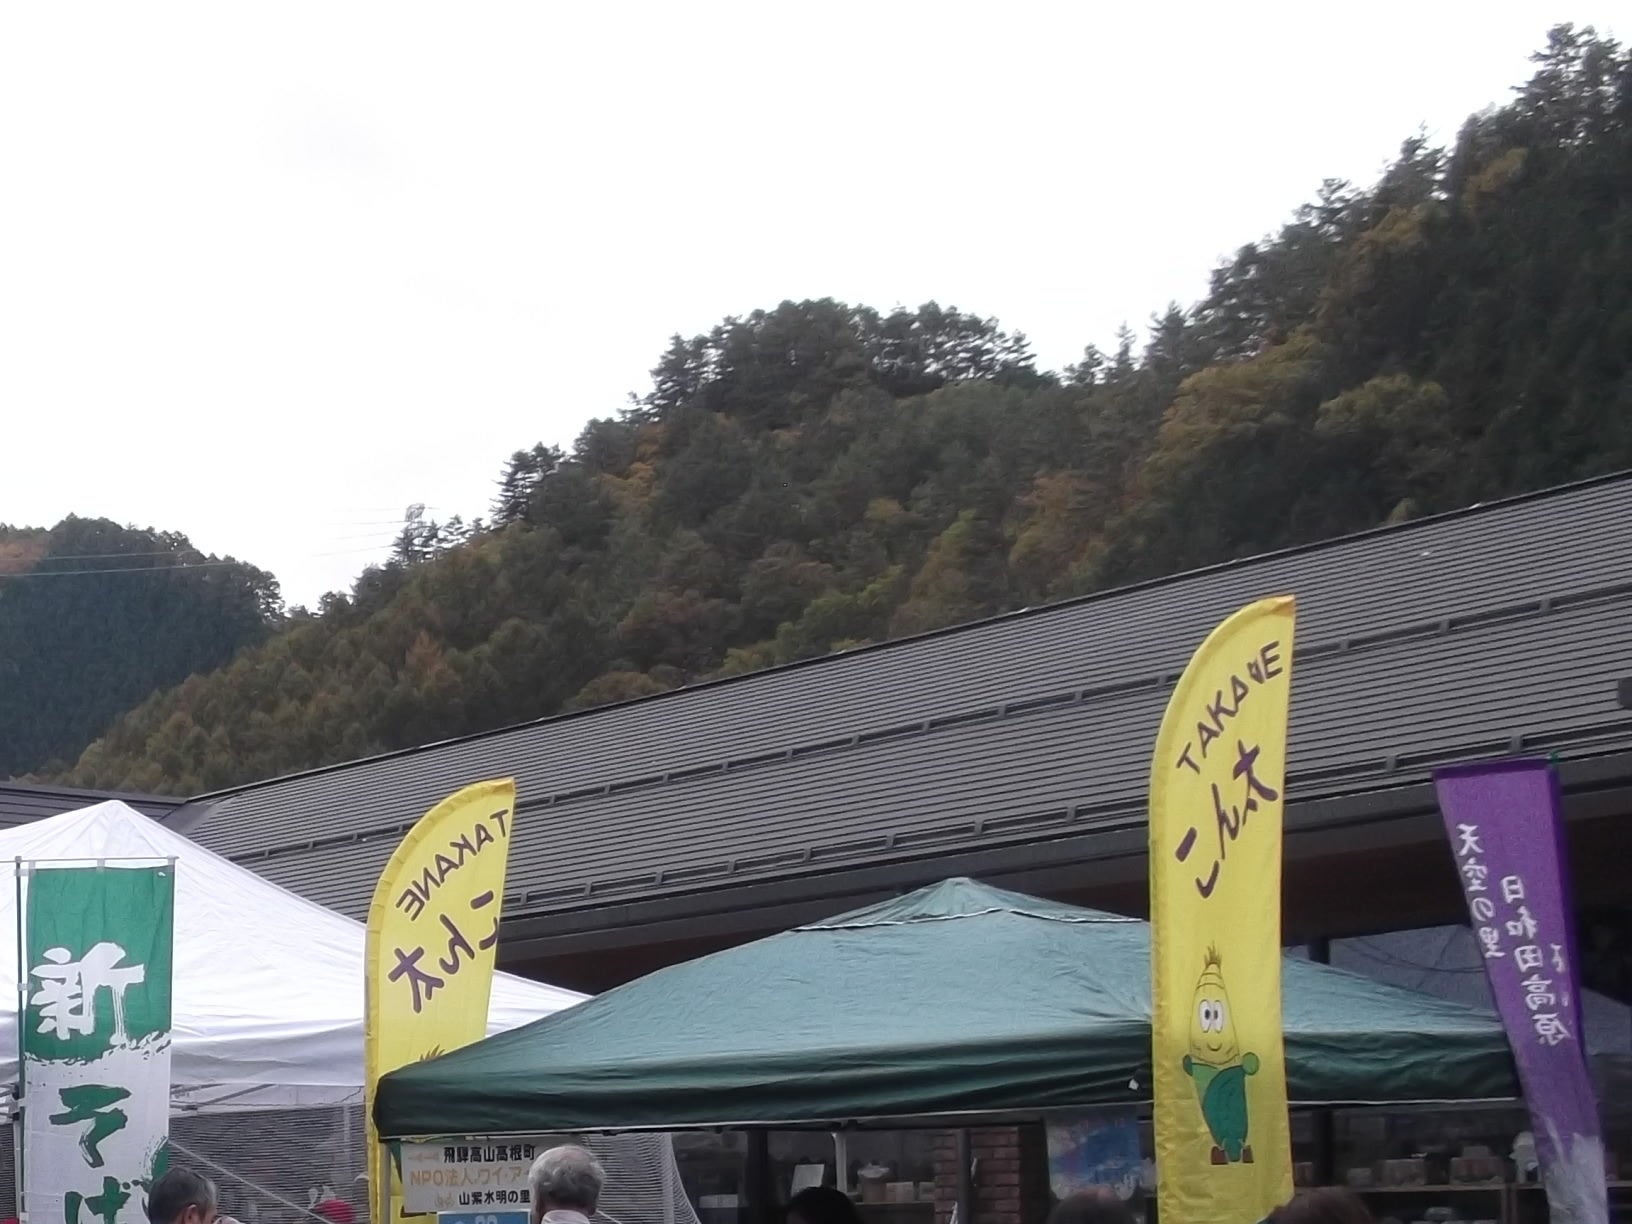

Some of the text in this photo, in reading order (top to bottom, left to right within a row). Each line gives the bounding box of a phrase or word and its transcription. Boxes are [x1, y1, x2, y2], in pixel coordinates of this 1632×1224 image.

[1175, 640, 1283, 775] TAKANE
[444, 1144, 535, 1163] 飛騨高山高根町
[410, 1166, 530, 1187] NPO法人ワイ・ア
[458, 1189, 531, 1206] 山紫水明の里
